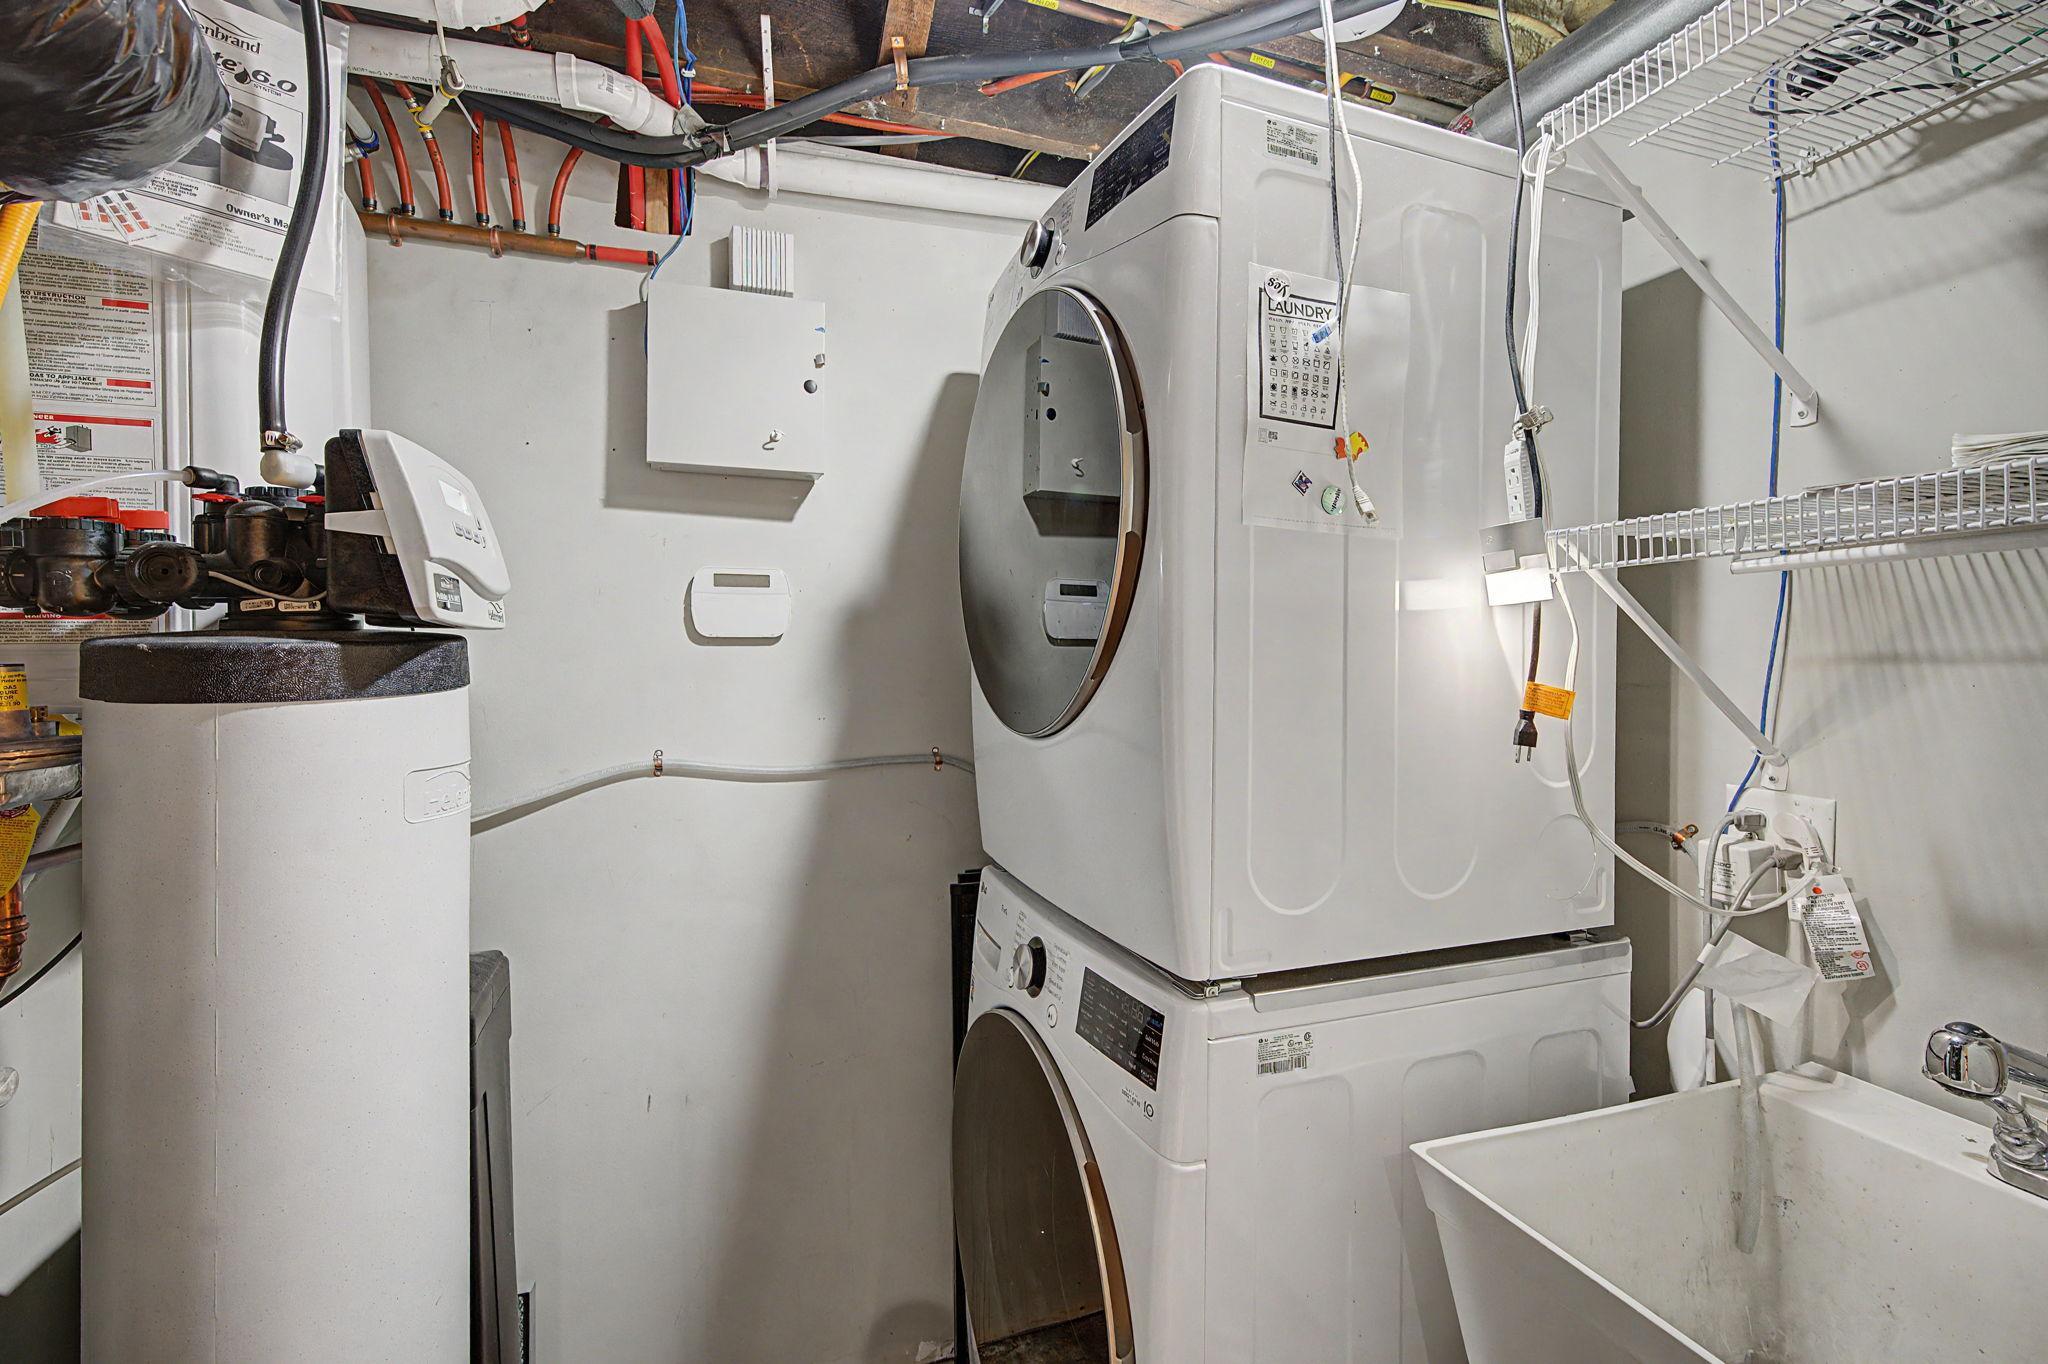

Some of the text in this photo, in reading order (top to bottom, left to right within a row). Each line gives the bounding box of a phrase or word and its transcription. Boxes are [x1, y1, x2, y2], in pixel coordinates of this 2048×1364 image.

[226, 203, 270, 224] Owner's
[1268, 297, 1332, 320] LAUNDRY
[58, 374, 97, 382] APPLIANCE
